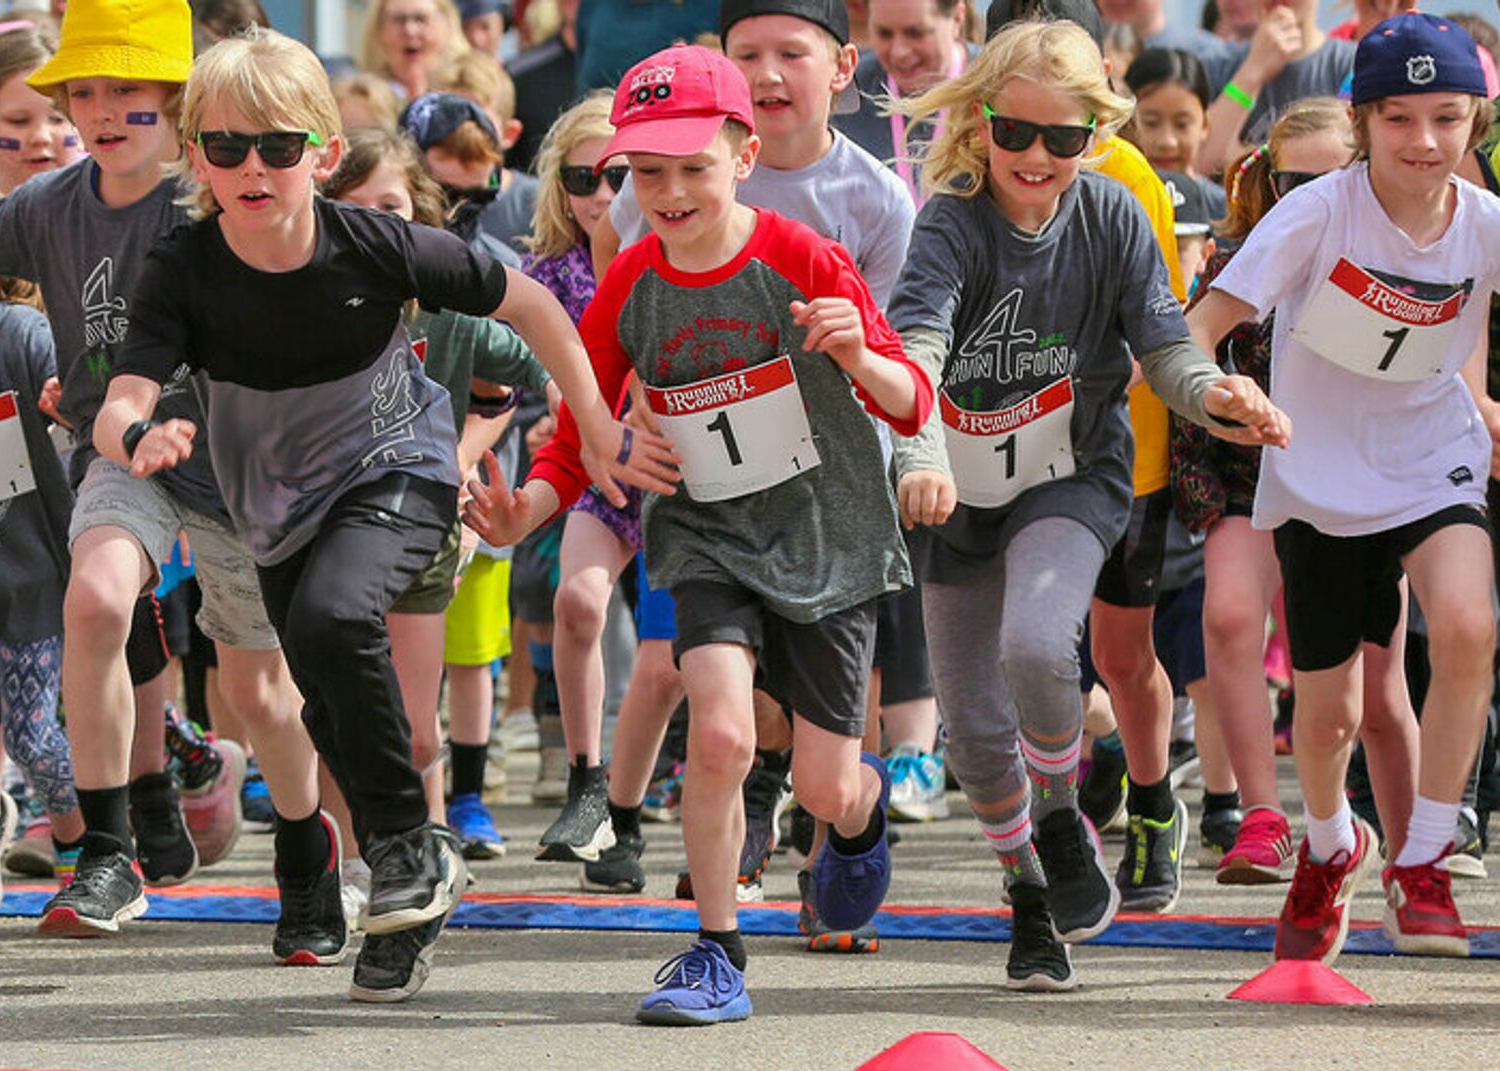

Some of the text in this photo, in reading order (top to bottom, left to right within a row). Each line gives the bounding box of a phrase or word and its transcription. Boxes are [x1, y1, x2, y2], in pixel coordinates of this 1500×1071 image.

[1373, 289, 1437, 319] Running
[1377, 327, 1411, 371] 1
[674, 377, 737, 412] Running
[971, 404, 1031, 433] Running
[707, 411, 743, 466] 1
[792, 456, 801, 470] 1
[994, 434, 1016, 479] 1
[1049, 463, 1056, 478] 1
[10, 480, 18, 493] 1
